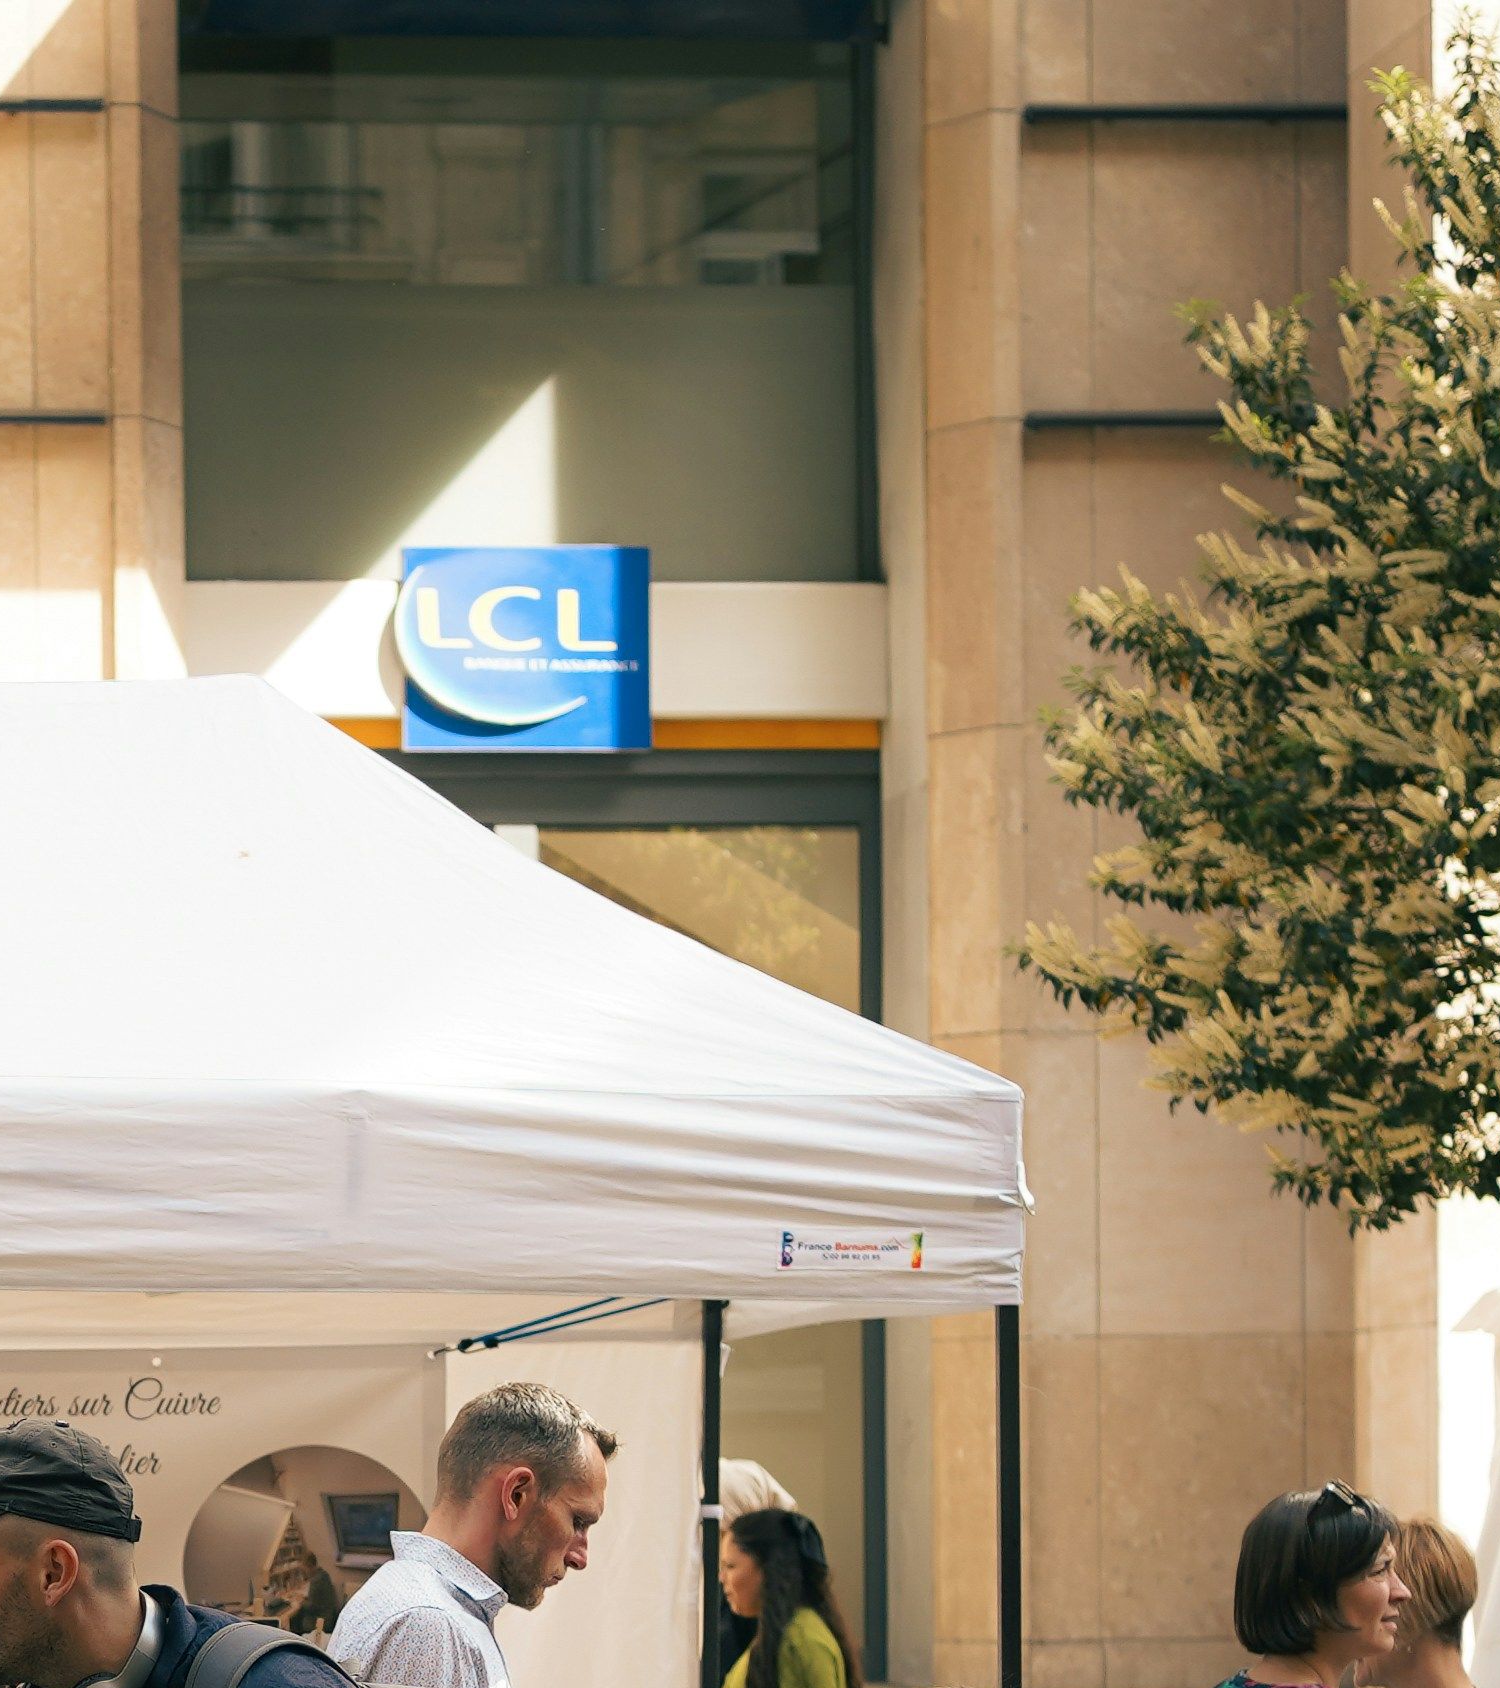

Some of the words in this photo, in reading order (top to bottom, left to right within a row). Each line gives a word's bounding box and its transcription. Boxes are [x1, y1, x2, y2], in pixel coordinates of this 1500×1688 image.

[416, 586, 619, 652] LCL
[68, 1392, 114, 1416] sur
[125, 1376, 222, 1420] Cuivre
